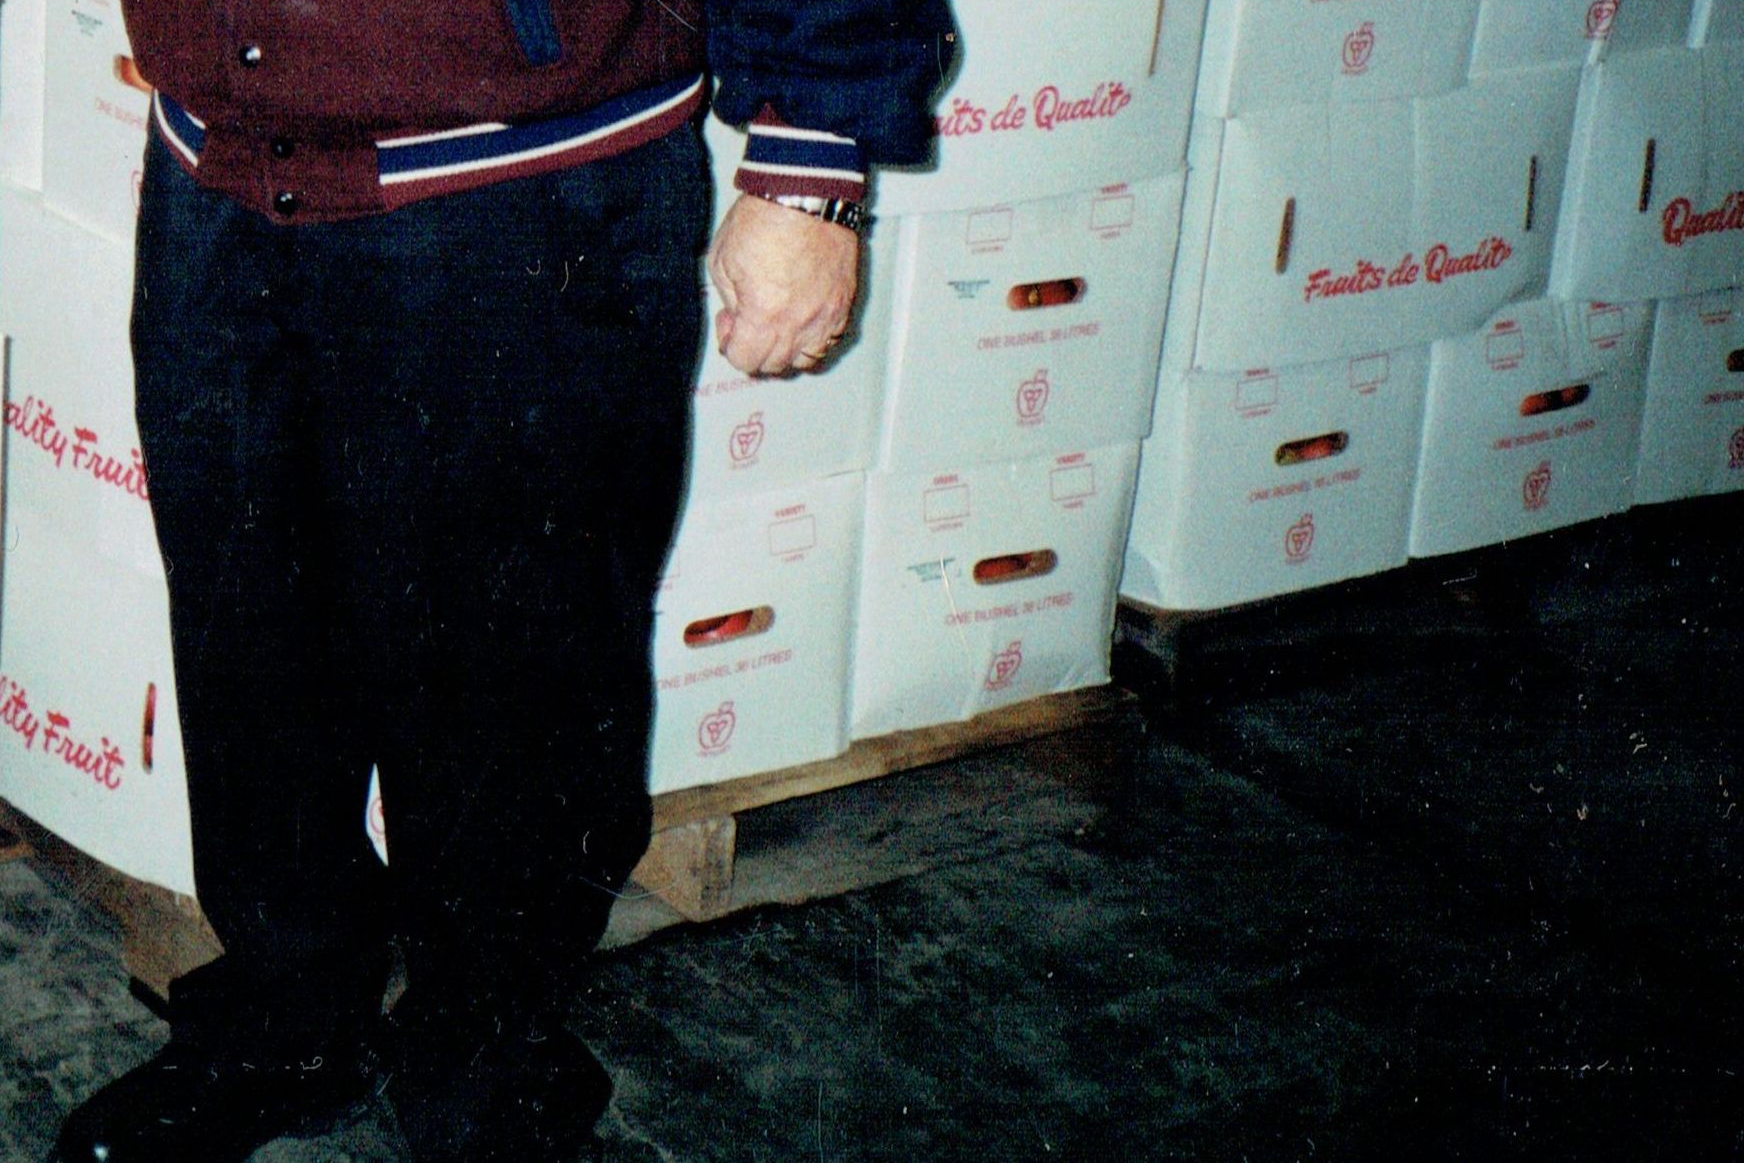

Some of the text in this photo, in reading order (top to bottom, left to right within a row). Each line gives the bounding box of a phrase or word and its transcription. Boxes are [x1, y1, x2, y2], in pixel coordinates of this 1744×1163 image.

[990, 94, 1026, 131] de
[1304, 260, 1384, 304] Fruits
[1387, 253, 1419, 287] de
[71, 426, 149, 501] Fruit
[44, 710, 125, 790] Fruit
